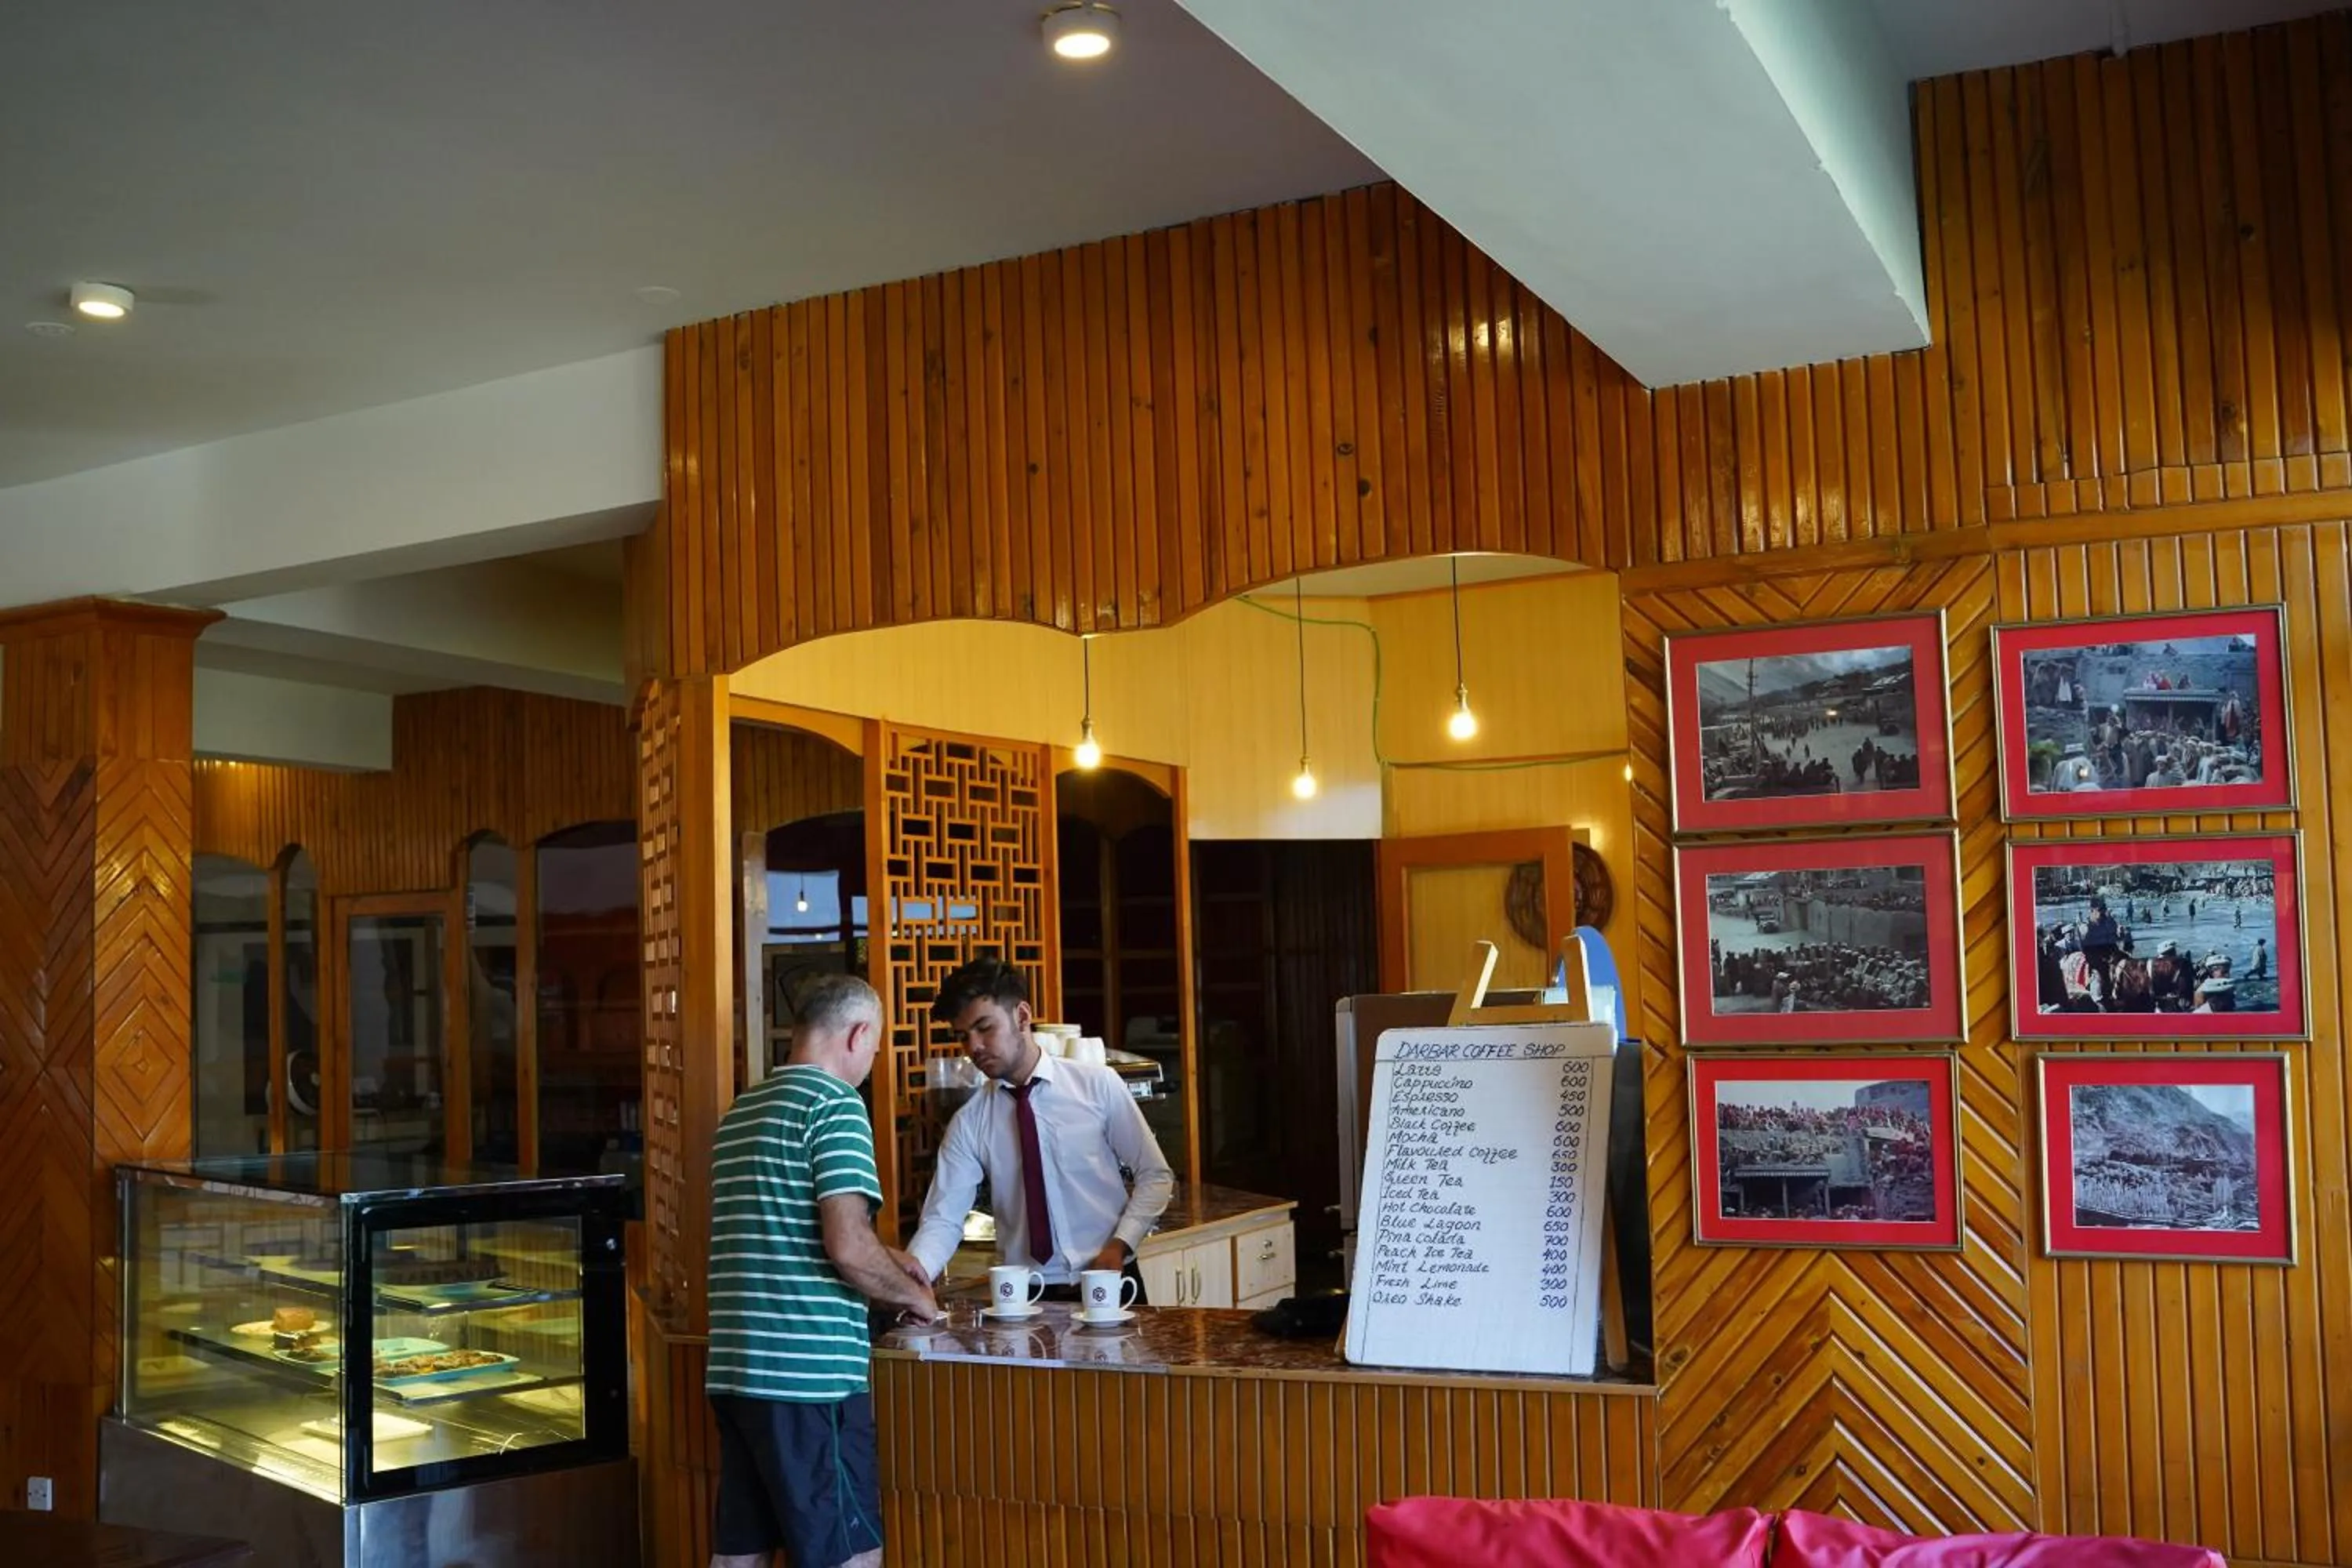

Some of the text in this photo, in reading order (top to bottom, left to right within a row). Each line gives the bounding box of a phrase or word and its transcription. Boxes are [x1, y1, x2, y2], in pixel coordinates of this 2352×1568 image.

[1394, 1040, 1566, 1059] DARBAR COFFEE SHOP
[1563, 1061, 1589, 1074] 600
[1393, 1075, 1588, 1094] Cappuccino 600
[1559, 1090, 1586, 1102] 450
[1558, 1103, 1584, 1117] 500
[1391, 1116, 1581, 1137] Black Coffee 600
[1553, 1134, 1580, 1148] 600
[1385, 1158, 1417, 1171] Milk
[1550, 1161, 1577, 1173] 300
[1438, 1174, 1463, 1188] Tea
[1548, 1175, 1574, 1189] 150
[1381, 1185, 1576, 1203] Iced Tea 300
[1382, 1202, 1406, 1214] Hot
[1545, 1205, 1573, 1218] 600
[1380, 1214, 1570, 1235] Blue Lagoon 650
[1543, 1235, 1570, 1247] 700
[1424, 1245, 1445, 1258] Ice
[1450, 1246, 1474, 1260] Tea
[1541, 1248, 1569, 1261] 400
[1375, 1259, 1569, 1276] Mint Lemonade 400
[1376, 1274, 1569, 1291] Fresh Lime 300
[1539, 1294, 1569, 1308] 500
